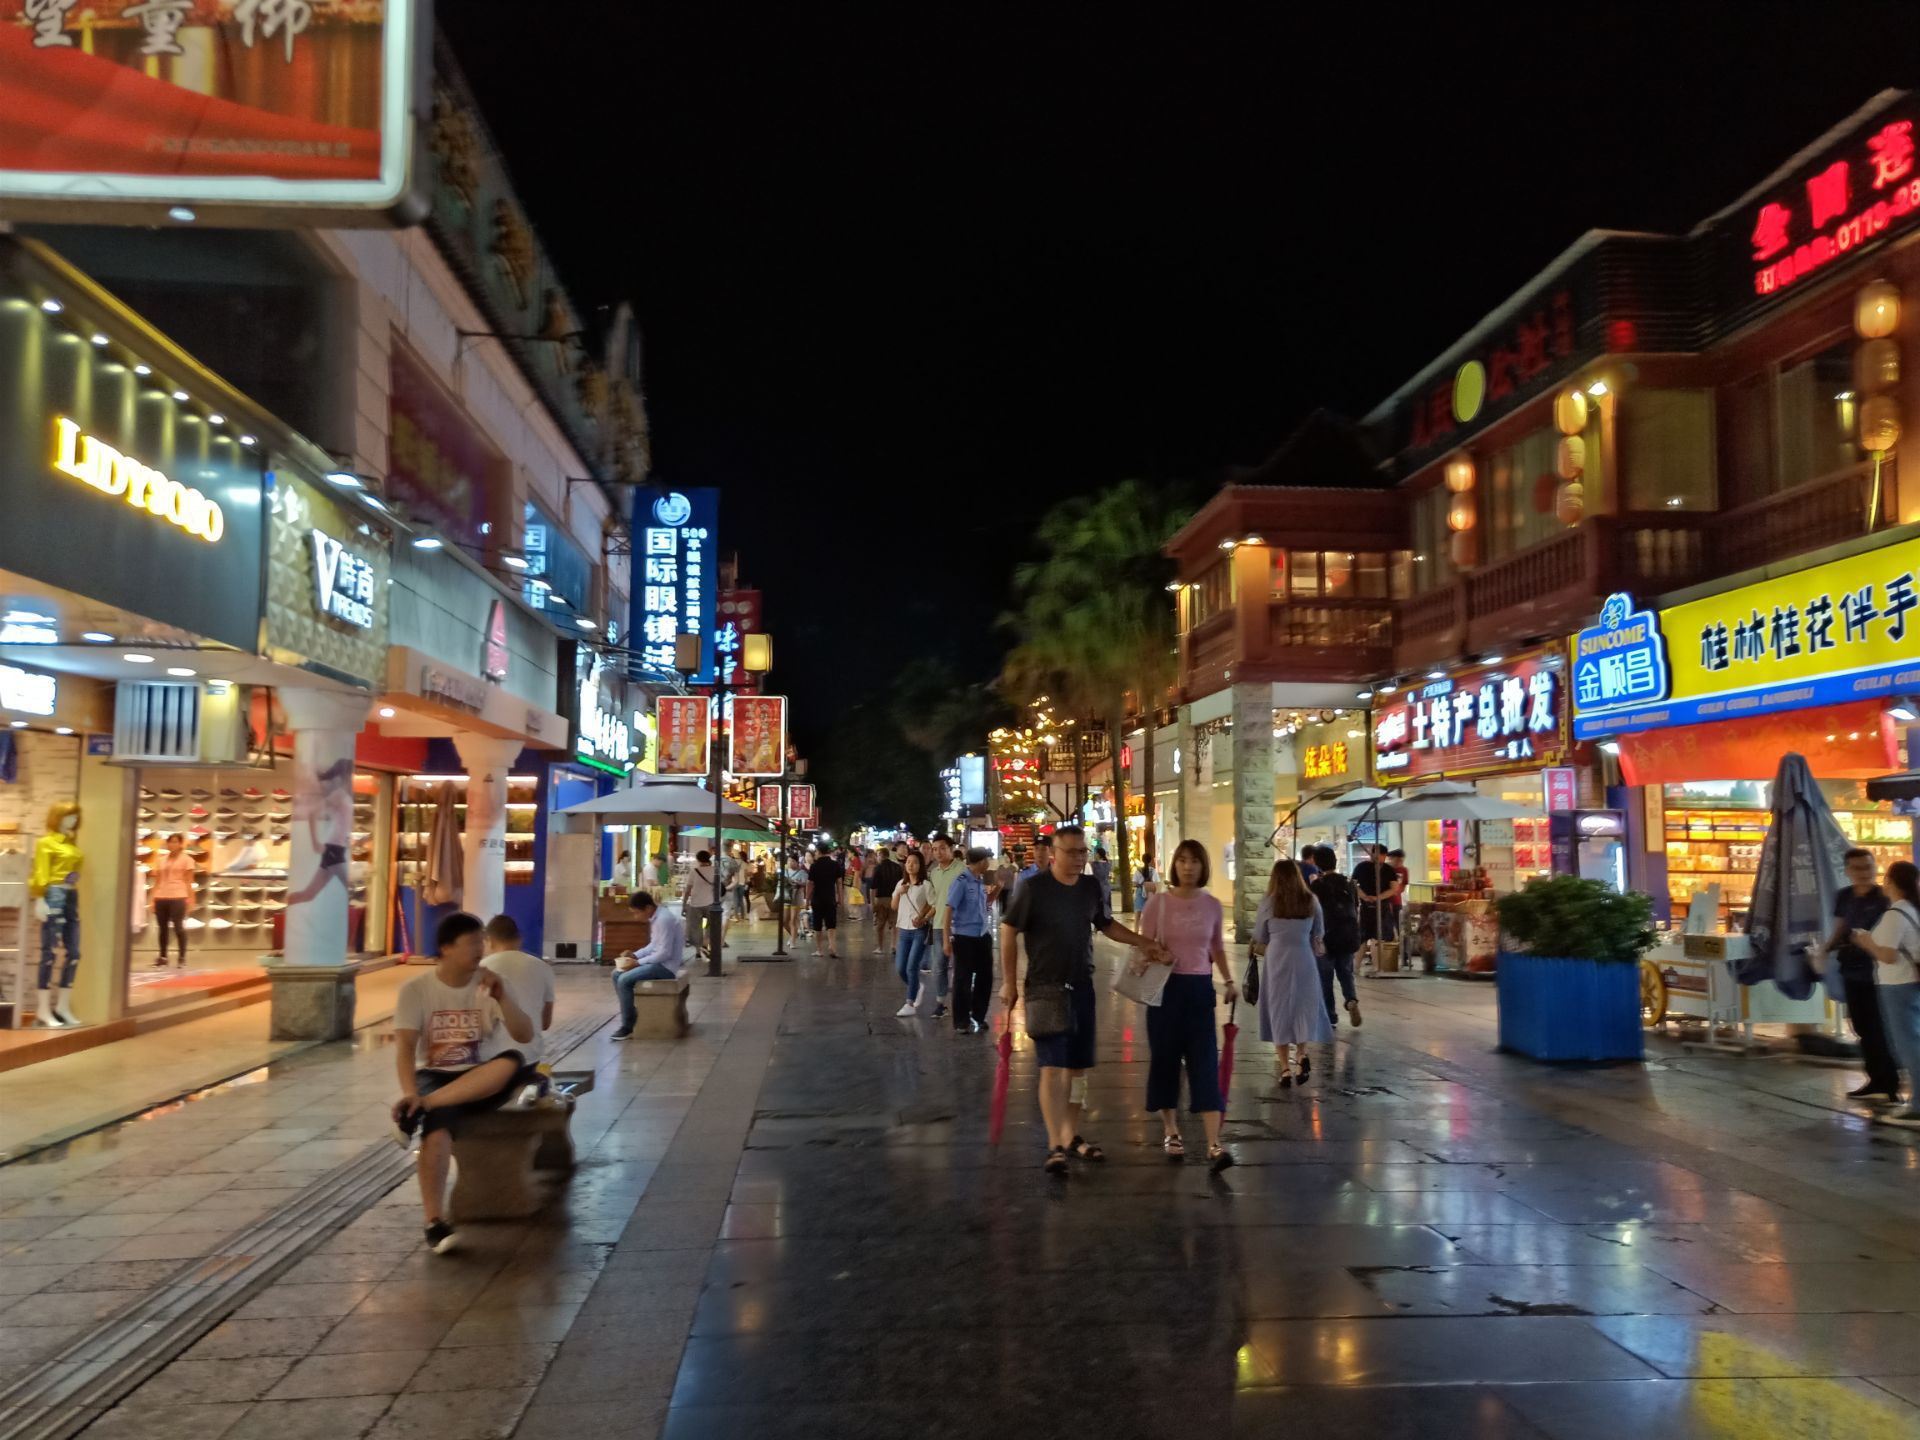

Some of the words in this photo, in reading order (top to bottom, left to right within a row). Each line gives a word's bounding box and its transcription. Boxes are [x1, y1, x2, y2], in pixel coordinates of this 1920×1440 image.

[1580, 624, 1646, 656] SUNCOME
[1700, 573, 1919, 671] 桂林桂花伴手
[1578, 647, 1655, 704] 金顺昌
[1412, 671, 1556, 750] 土特产总批发
[433, 1013, 458, 1029] RIO
[461, 1012, 481, 1028] DE
